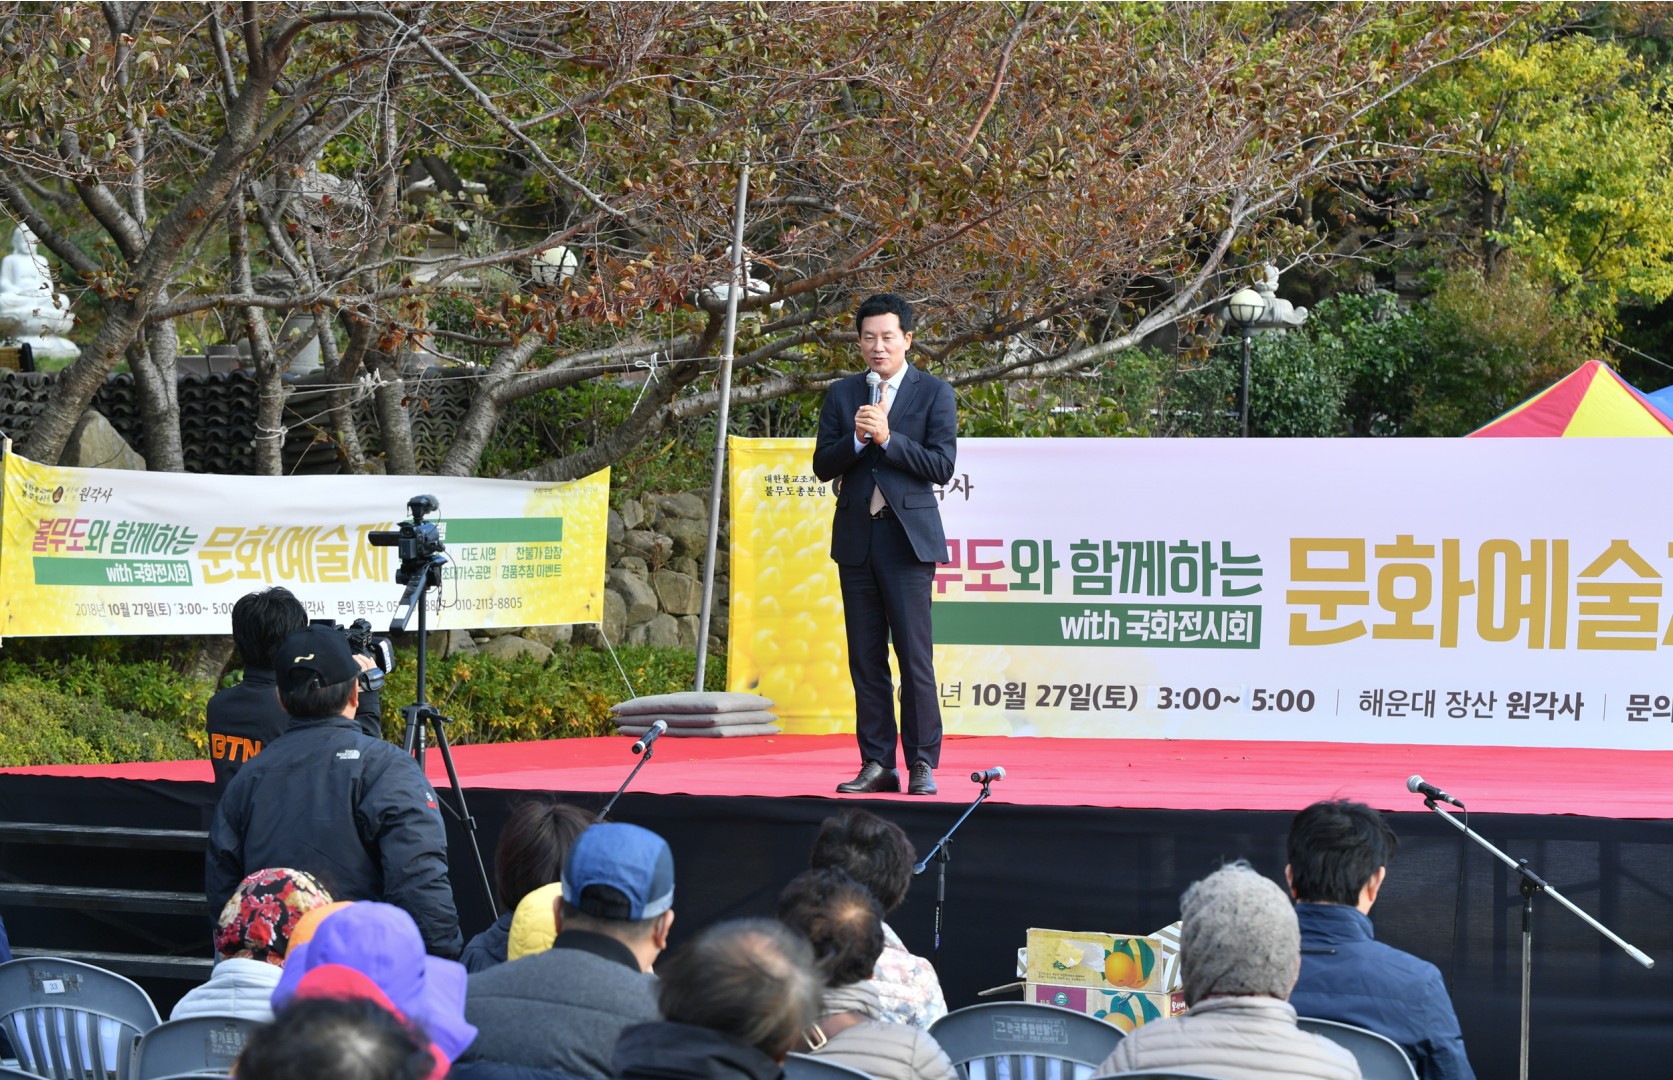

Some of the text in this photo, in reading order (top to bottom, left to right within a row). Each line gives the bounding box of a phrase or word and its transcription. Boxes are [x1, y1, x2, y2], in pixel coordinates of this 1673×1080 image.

[764, 474, 824, 484] 대한불교조계
[80, 486, 113, 503] 원각사
[764, 485, 826, 497] 불무도총본원
[32, 518, 198, 555] 불무도와 함께하는
[198, 521, 393, 584] 문화예술제
[516, 546, 563, 560] 찬불가 합창
[105, 563, 190, 583] with 국화전시회
[442, 565, 491, 580] 초대가수공연
[501, 564, 562, 579] 경품추첨 이벤트
[932, 538, 1264, 597] 무도와 함께하는
[1286, 534, 1673, 652] 문화예술
[75, 603, 106, 618] 2018년
[108, 602, 130, 617] 10월
[133, 603, 172, 617] 27일(토)
[212, 602, 234, 615] 5:00
[337, 601, 355, 615] 문의
[357, 600, 384, 615] 종무소
[455, 597, 523, 611] 010-2113-8805
[1060, 609, 1254, 643] with 국화전시회
[972, 681, 1027, 711] 10월
[1035, 683, 1139, 712] 27일(토)
[1157, 687, 1240, 711] 3:00~
[1252, 688, 1316, 712] 5:00
[1359, 688, 1436, 718] 해운대
[1445, 690, 1497, 718] 장산
[1506, 691, 1584, 721] 원각사
[1626, 694, 1673, 723] 문의
[211, 733, 261, 763] BTN
